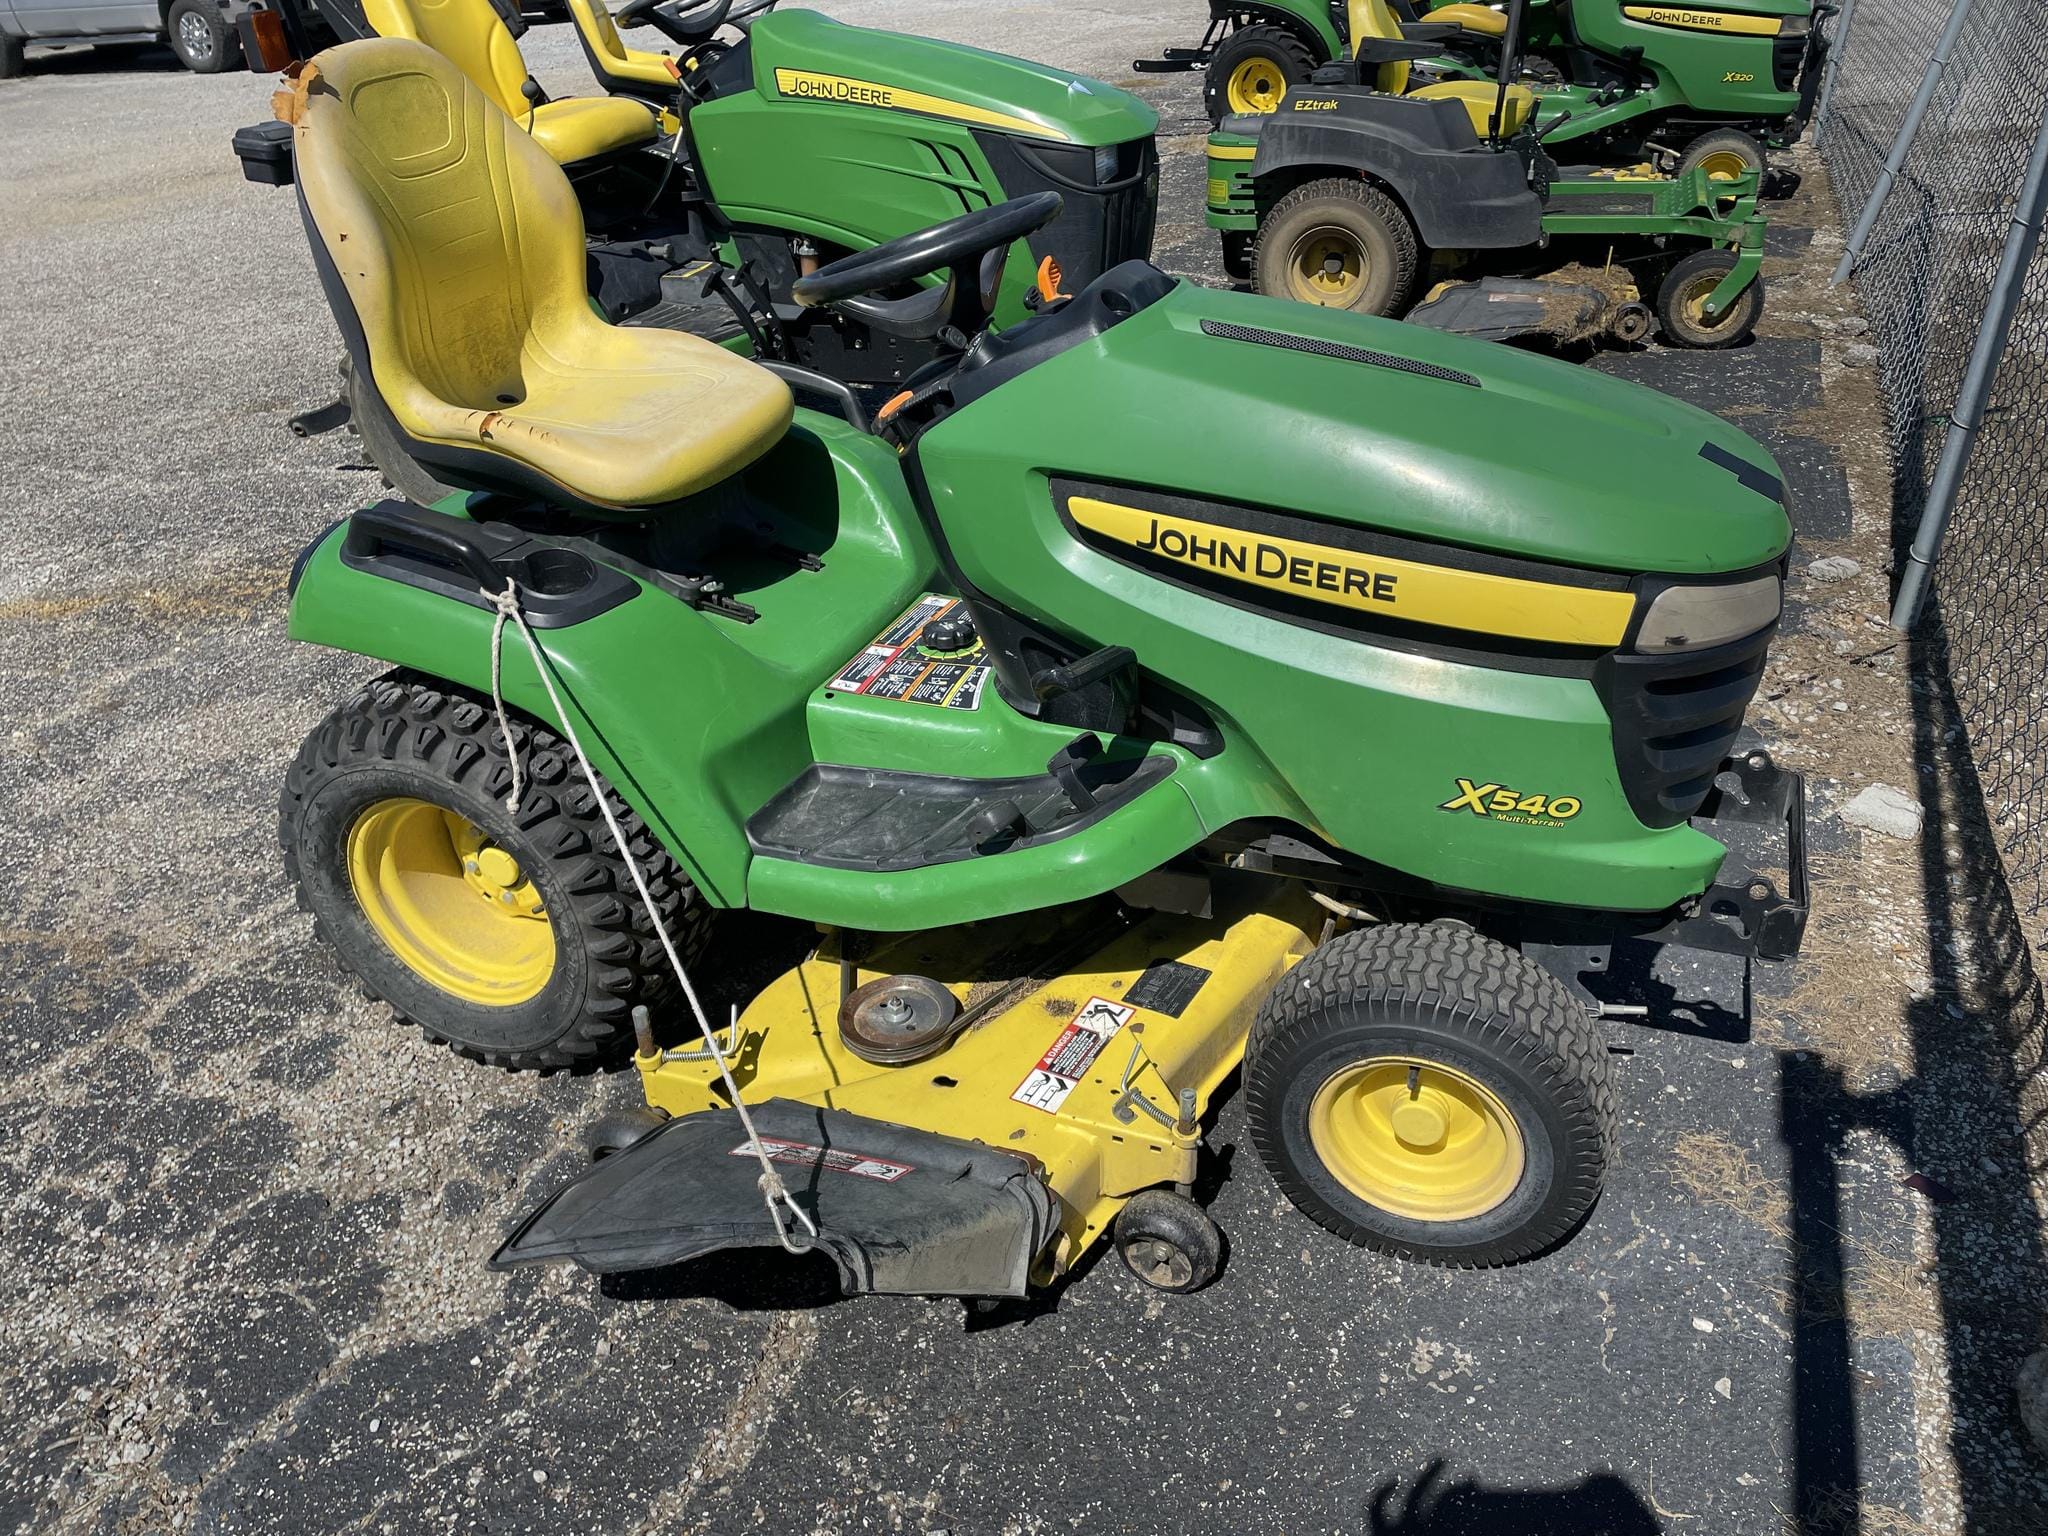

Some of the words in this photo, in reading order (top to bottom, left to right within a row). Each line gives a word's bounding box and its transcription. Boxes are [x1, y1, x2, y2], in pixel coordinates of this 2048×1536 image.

[1646, 10, 1680, 21] JOHN
[1682, 13, 1722, 26] DEERE
[1722, 71, 1754, 82] X320
[790, 77, 832, 96] JOHN
[837, 82, 892, 105] DEERE
[1294, 99, 1339, 111] EZtrak
[1136, 519, 1247, 573] JOHN
[1255, 543, 1398, 602] DEERE
[1438, 777, 1582, 818] X540
[1496, 813, 1565, 828] Multi-Terrain
[1047, 1029, 1074, 1058] DANGER
